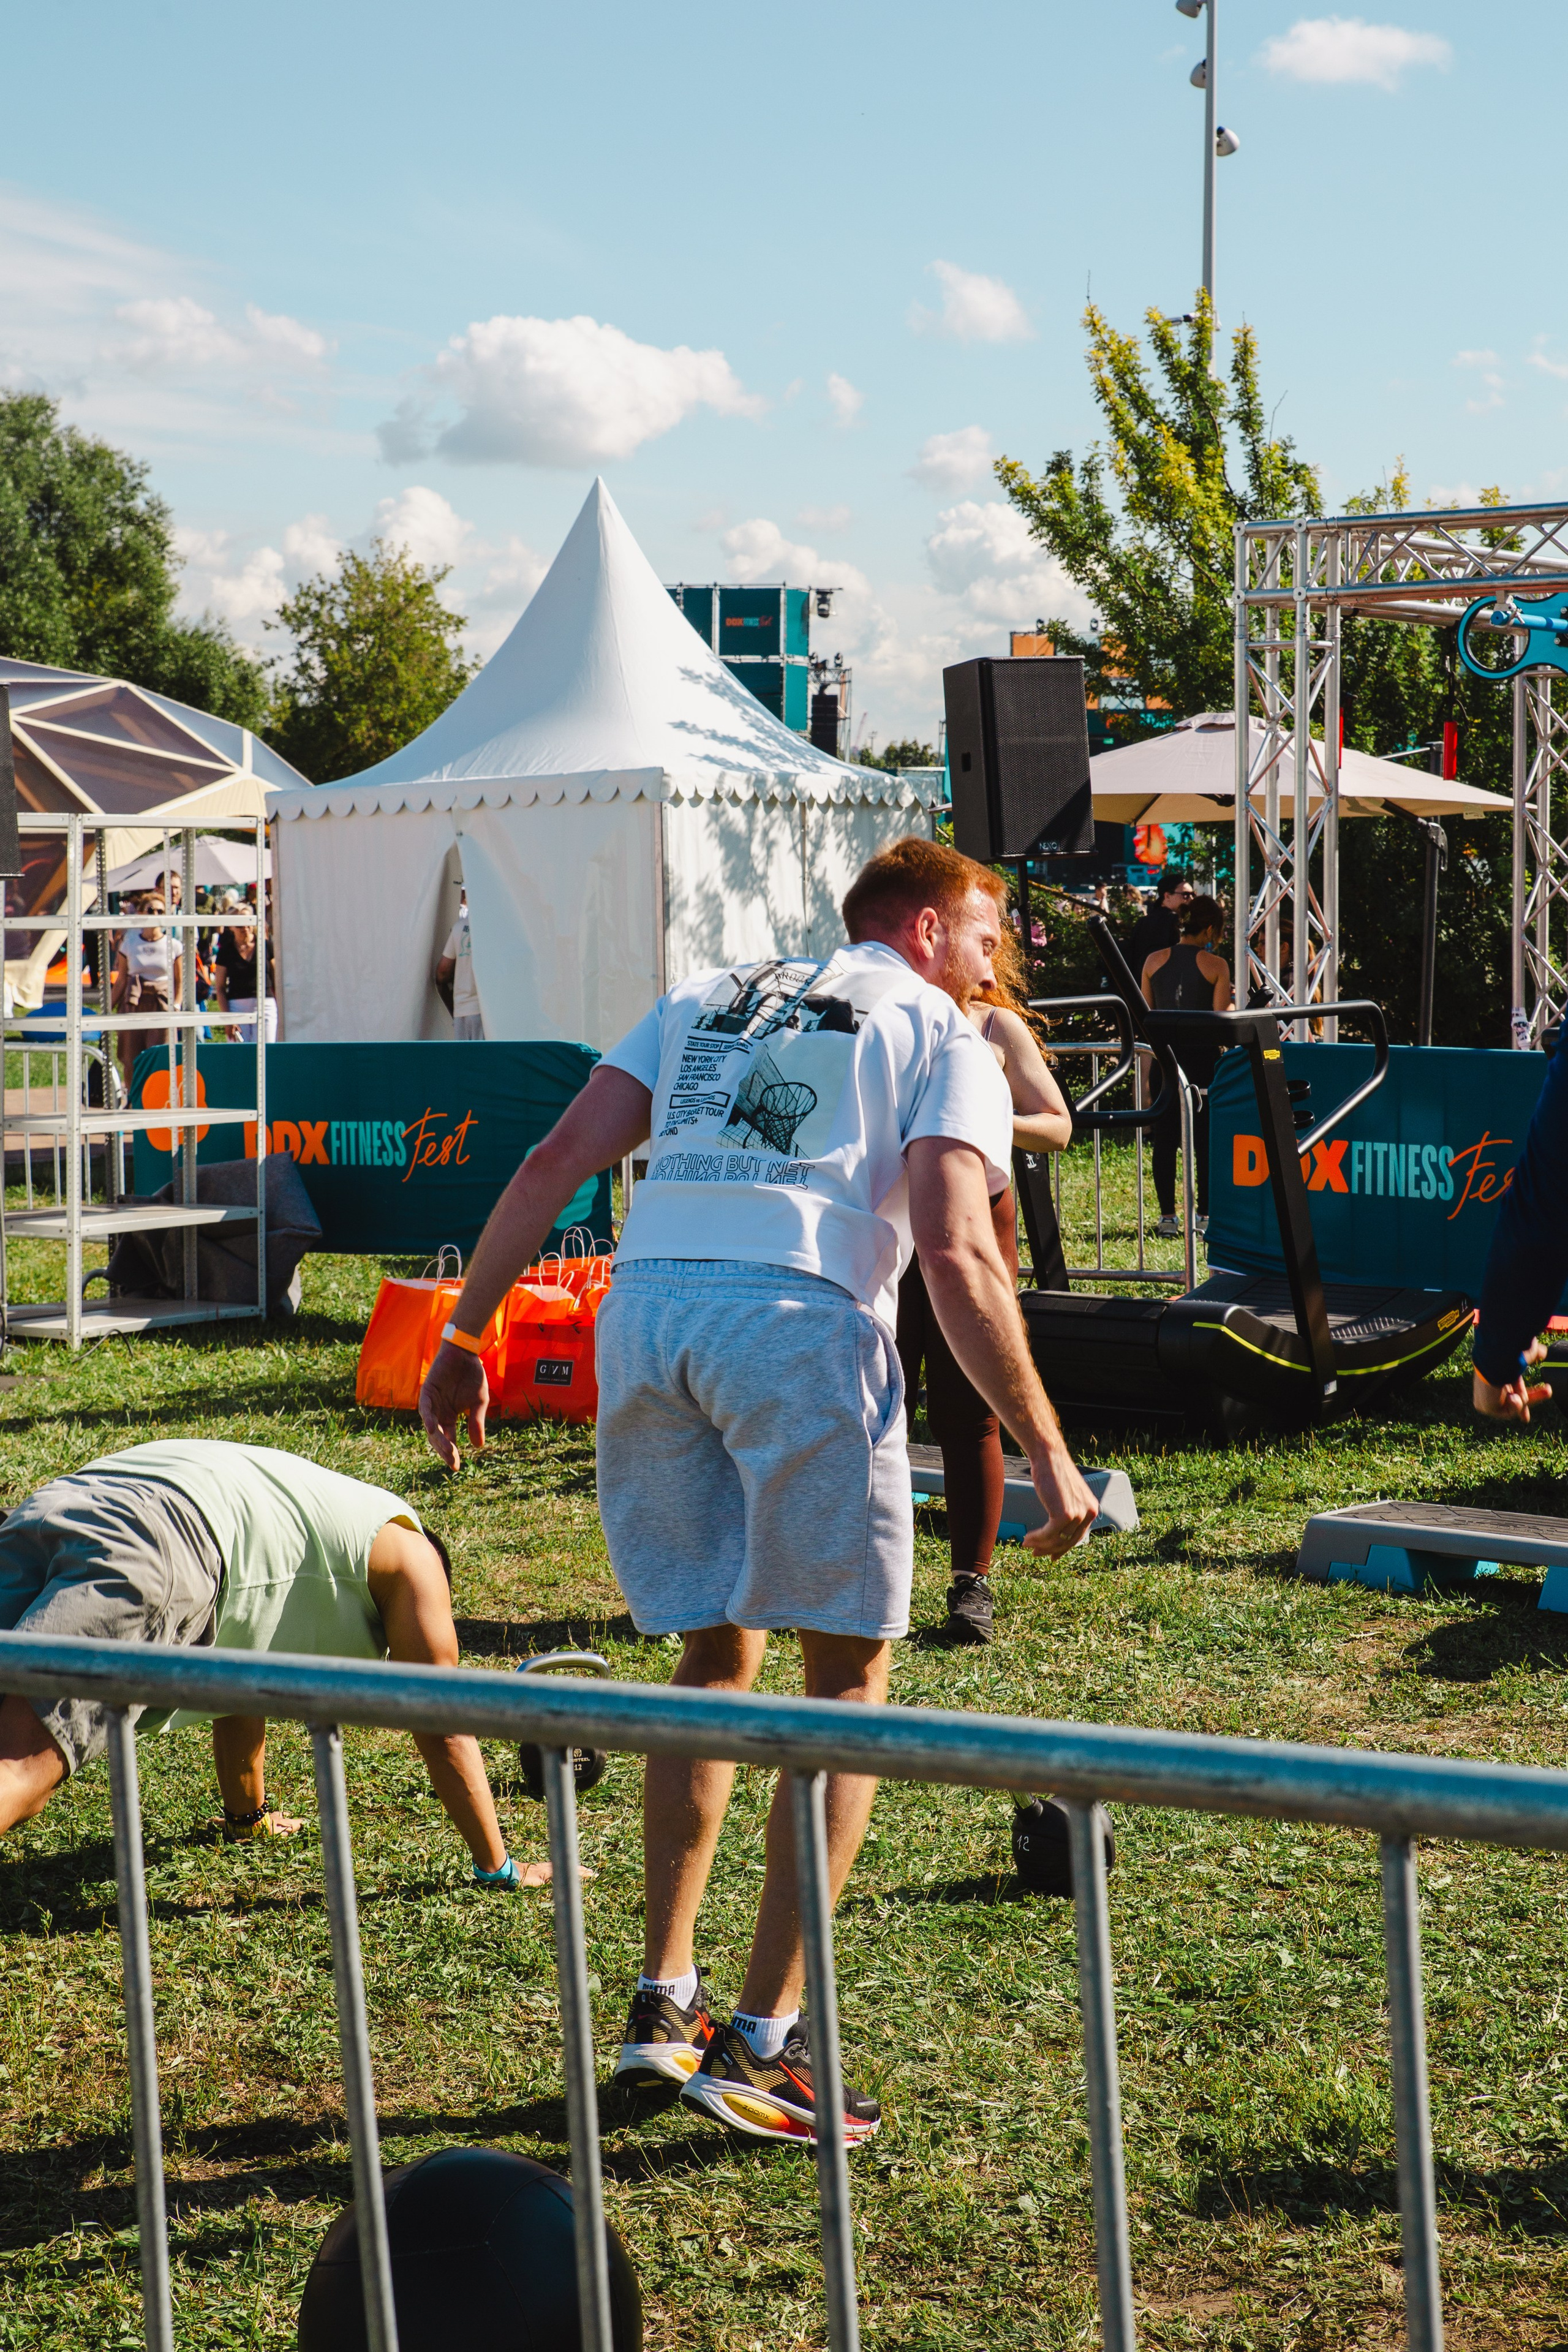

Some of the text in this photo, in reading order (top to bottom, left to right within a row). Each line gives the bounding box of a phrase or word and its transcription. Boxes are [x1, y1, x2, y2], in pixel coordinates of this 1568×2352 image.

[1039, 842, 1057, 850] NEXO
[682, 1054, 698, 1063] NEW
[698, 1055, 714, 1063] YORK
[676, 1110, 687, 1118] CITY
[705, 1107, 725, 1117] TOUR
[331, 1121, 407, 1166] FITNESS
[401, 1107, 479, 1183] Fest
[654, 1153, 815, 1177] NOTHING BUT NET
[1233, 1131, 1516, 1221] DX FITNESS Fe
[1017, 1835, 1030, 1851] 12
